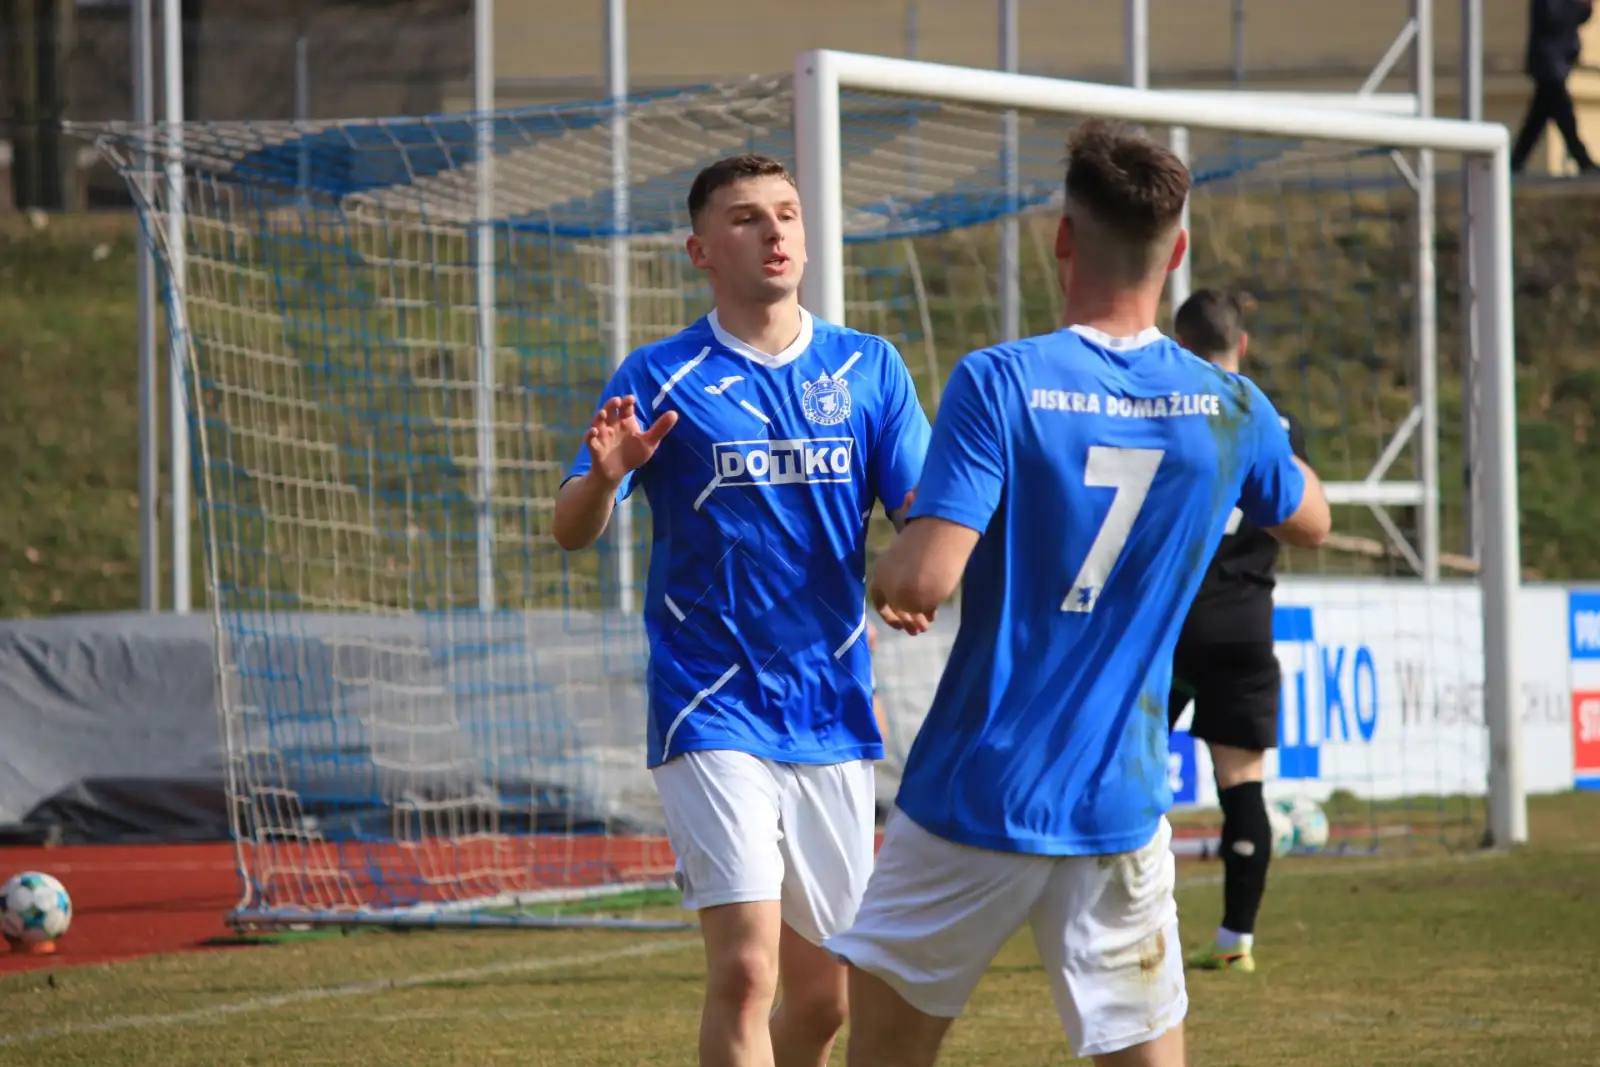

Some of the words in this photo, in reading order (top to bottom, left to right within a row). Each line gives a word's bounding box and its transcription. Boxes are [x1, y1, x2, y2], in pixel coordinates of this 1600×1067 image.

[1030, 389, 1100, 414] JISKRA
[1106, 391, 1220, 418] DOMAŽLICE
[720, 445, 850, 478] DOTIKO
[1060, 446, 1165, 612] 7
